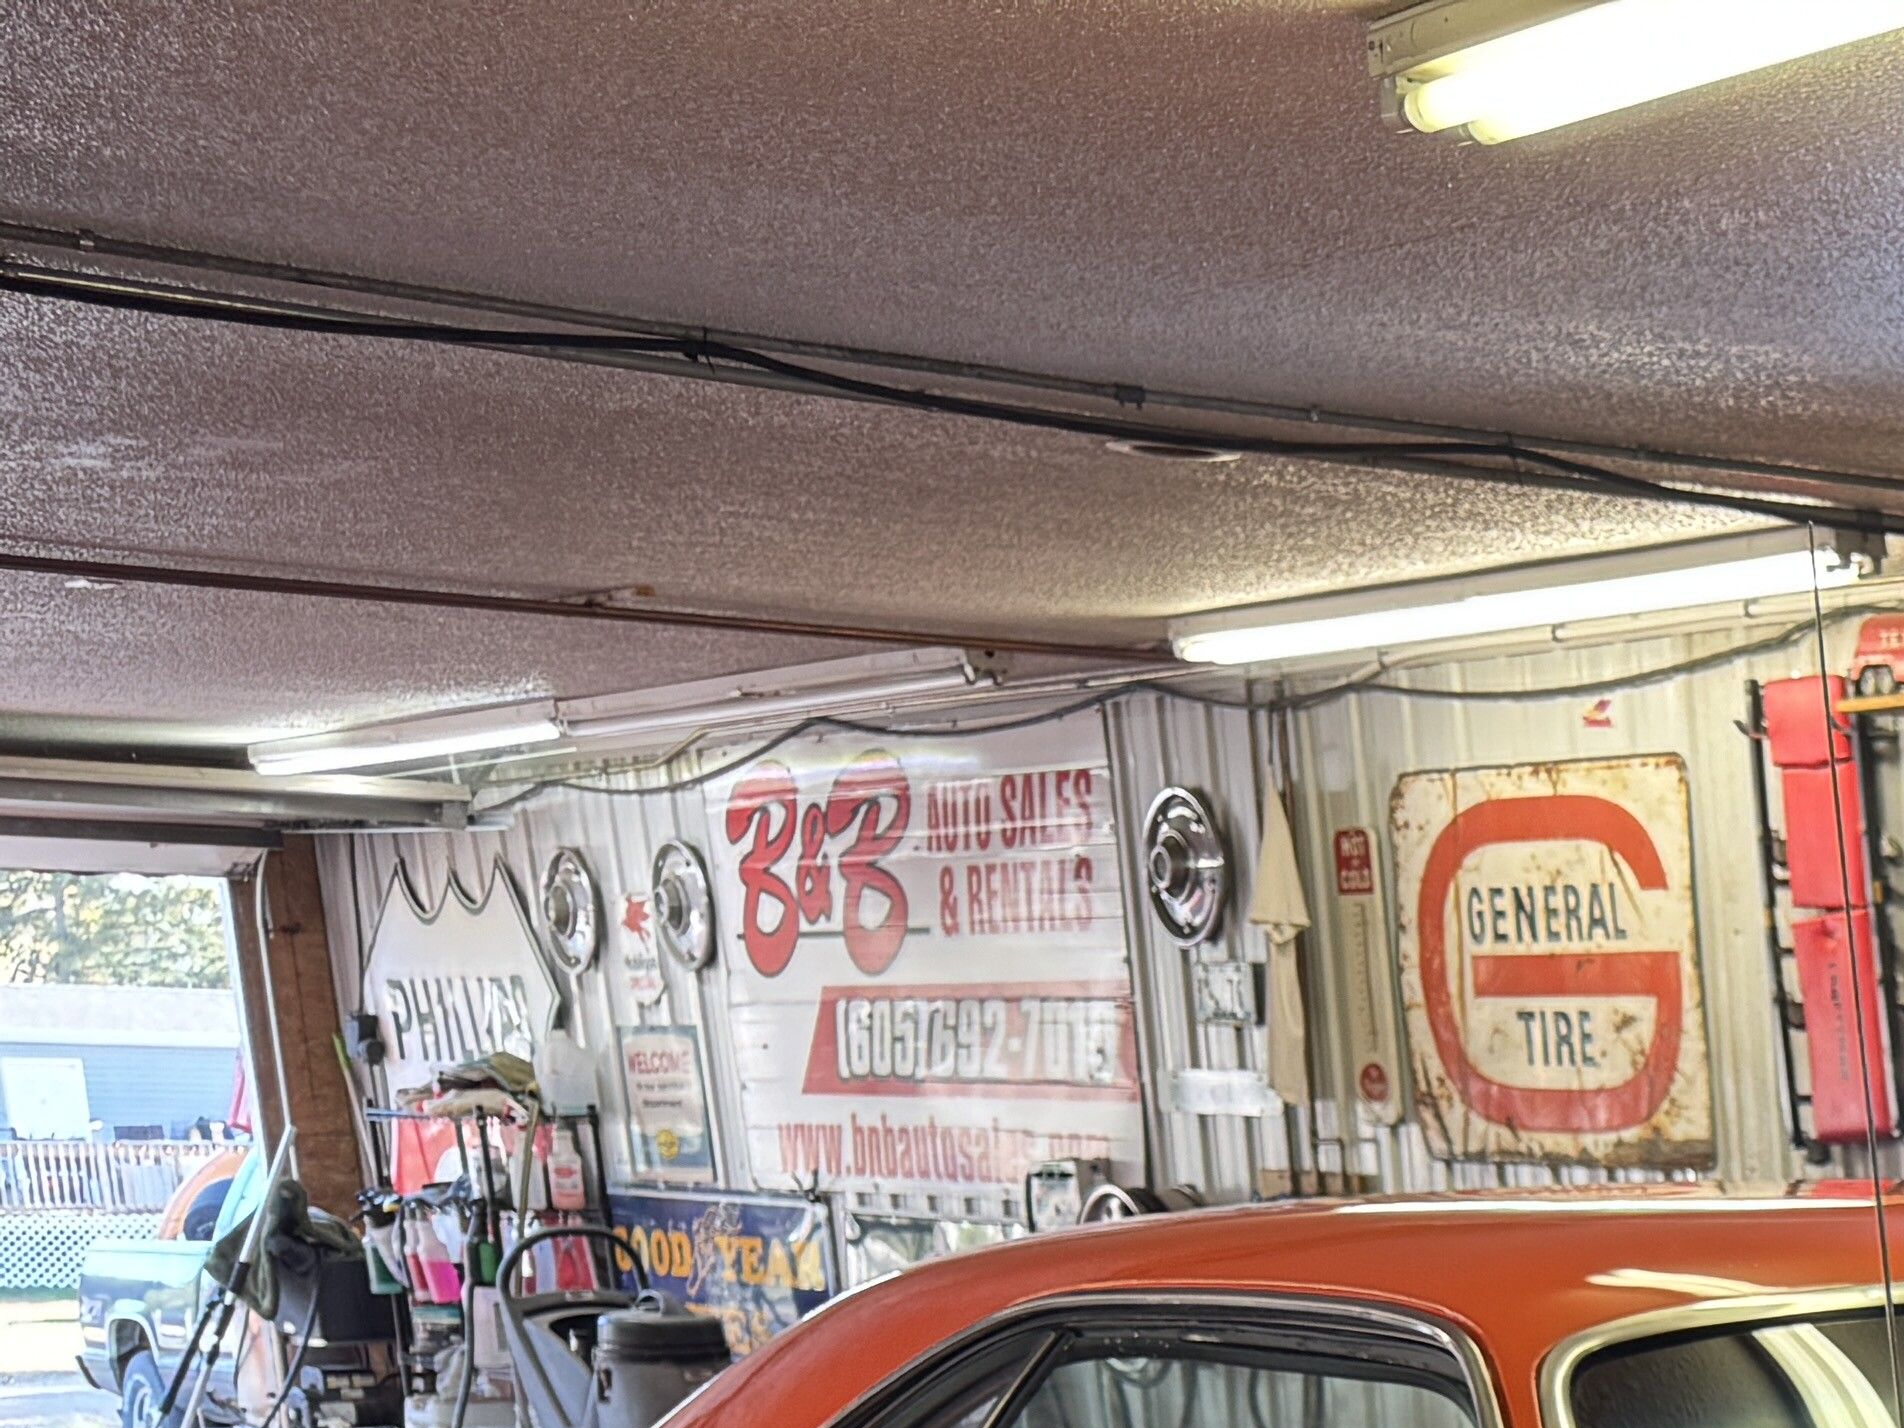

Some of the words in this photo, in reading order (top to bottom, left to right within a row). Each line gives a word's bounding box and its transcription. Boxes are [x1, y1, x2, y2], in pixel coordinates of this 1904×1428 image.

[925, 783, 992, 853] AUTO
[1000, 768, 1095, 851] SALES
[724, 746, 912, 979] B&B
[938, 864, 960, 936] &
[966, 856, 1095, 937] RENTALS
[1467, 882, 1627, 946] GENERAL
[386, 974, 534, 1062] PHILL
[1515, 1009, 1603, 1069] TIRE
